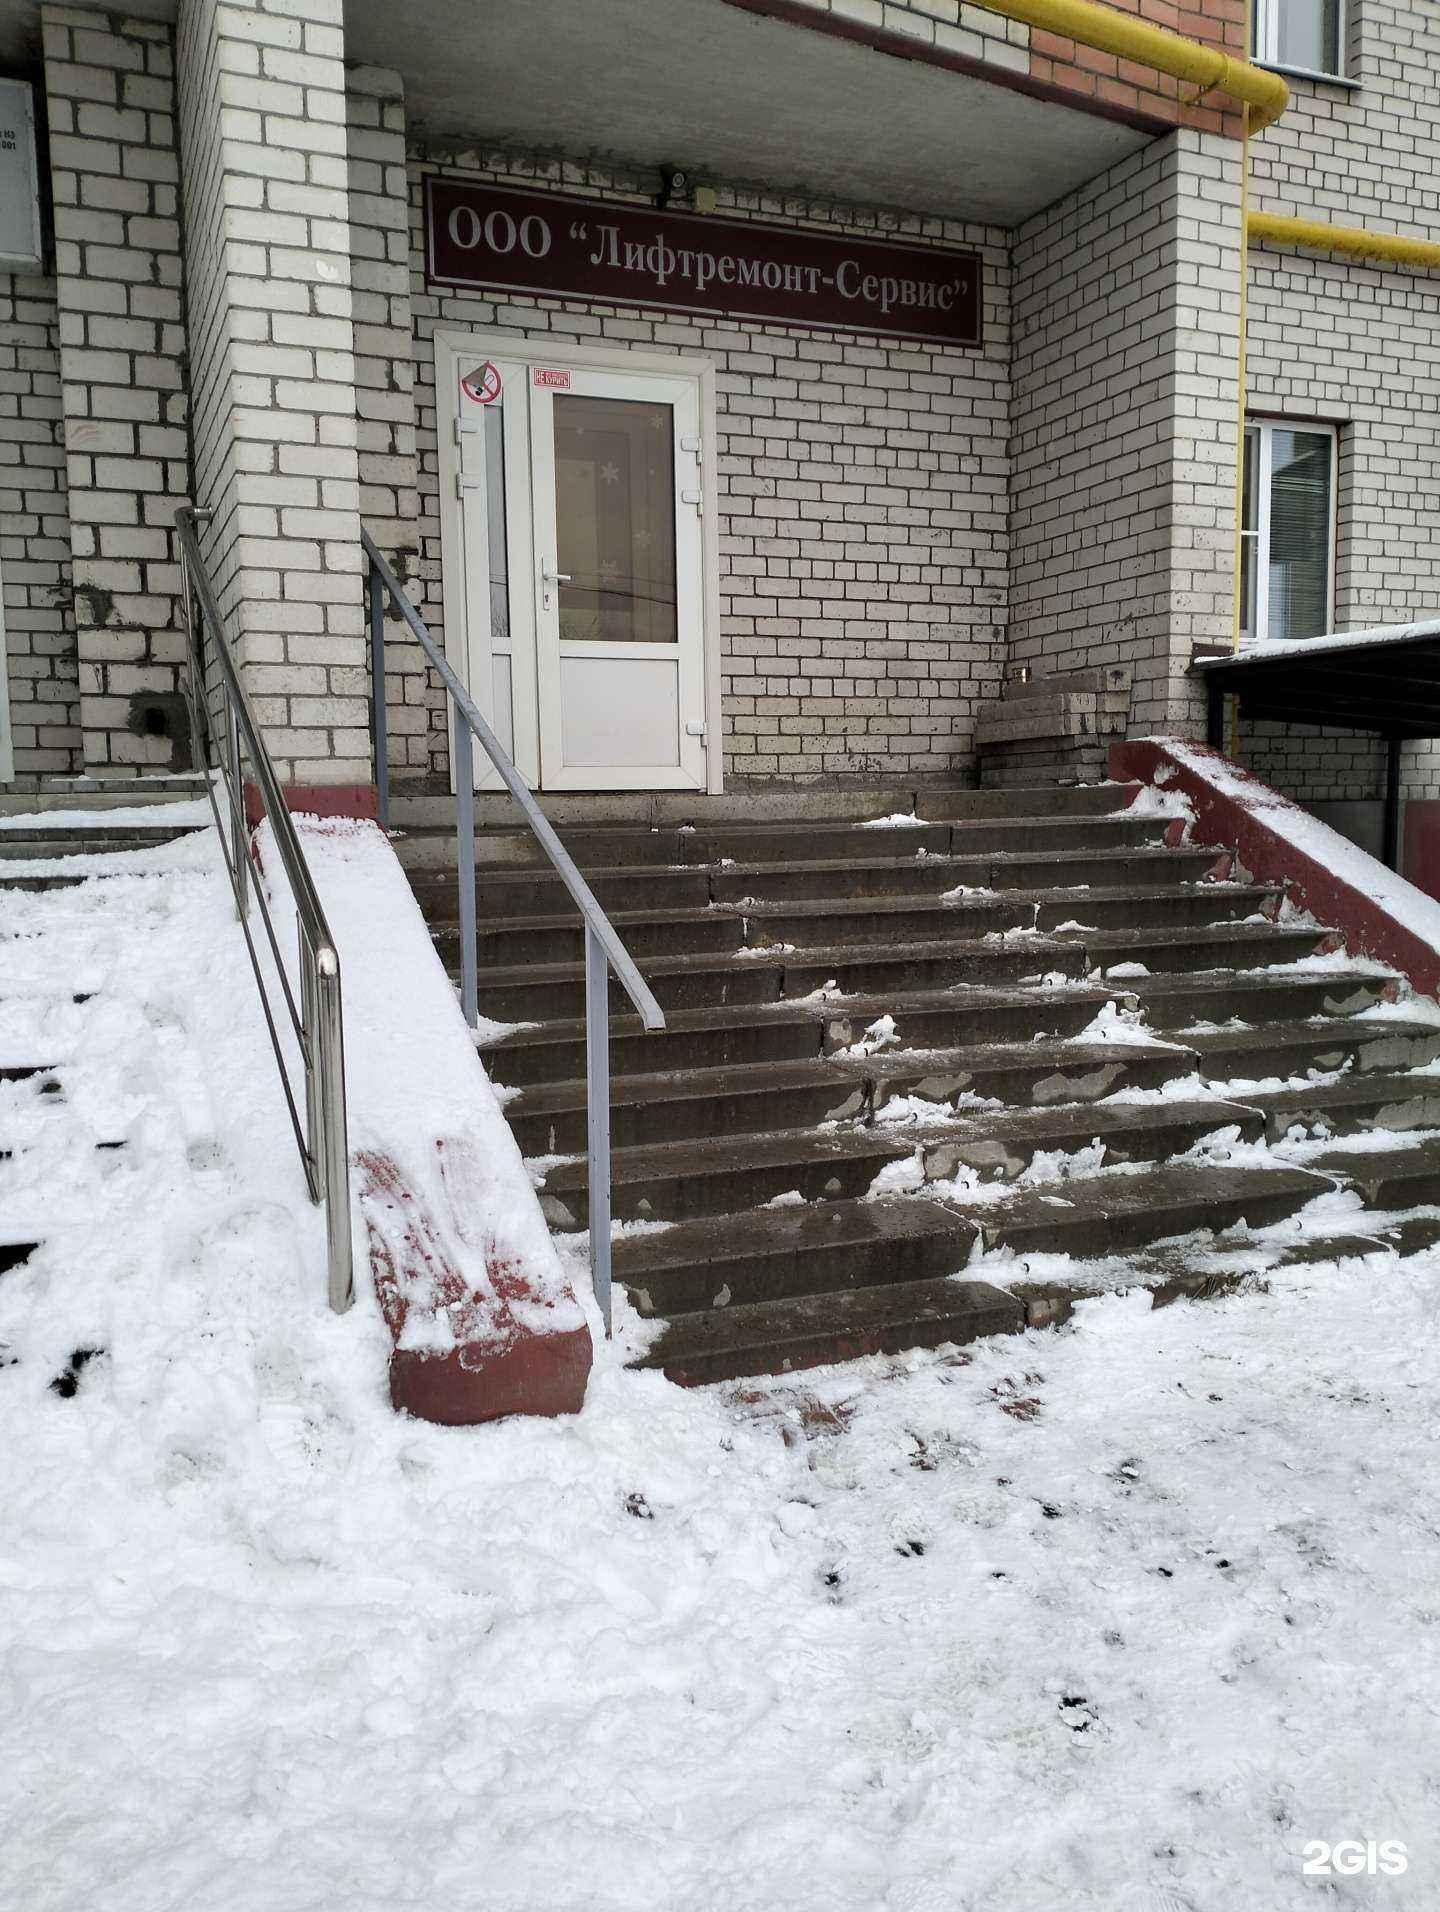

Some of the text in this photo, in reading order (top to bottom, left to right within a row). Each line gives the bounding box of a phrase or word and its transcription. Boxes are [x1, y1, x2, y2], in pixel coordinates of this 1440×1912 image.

[449, 205, 968, 312] ООО “Лифтремонт-Сервис”
[536, 371, 568, 386] НЕ КУРИТЬ
